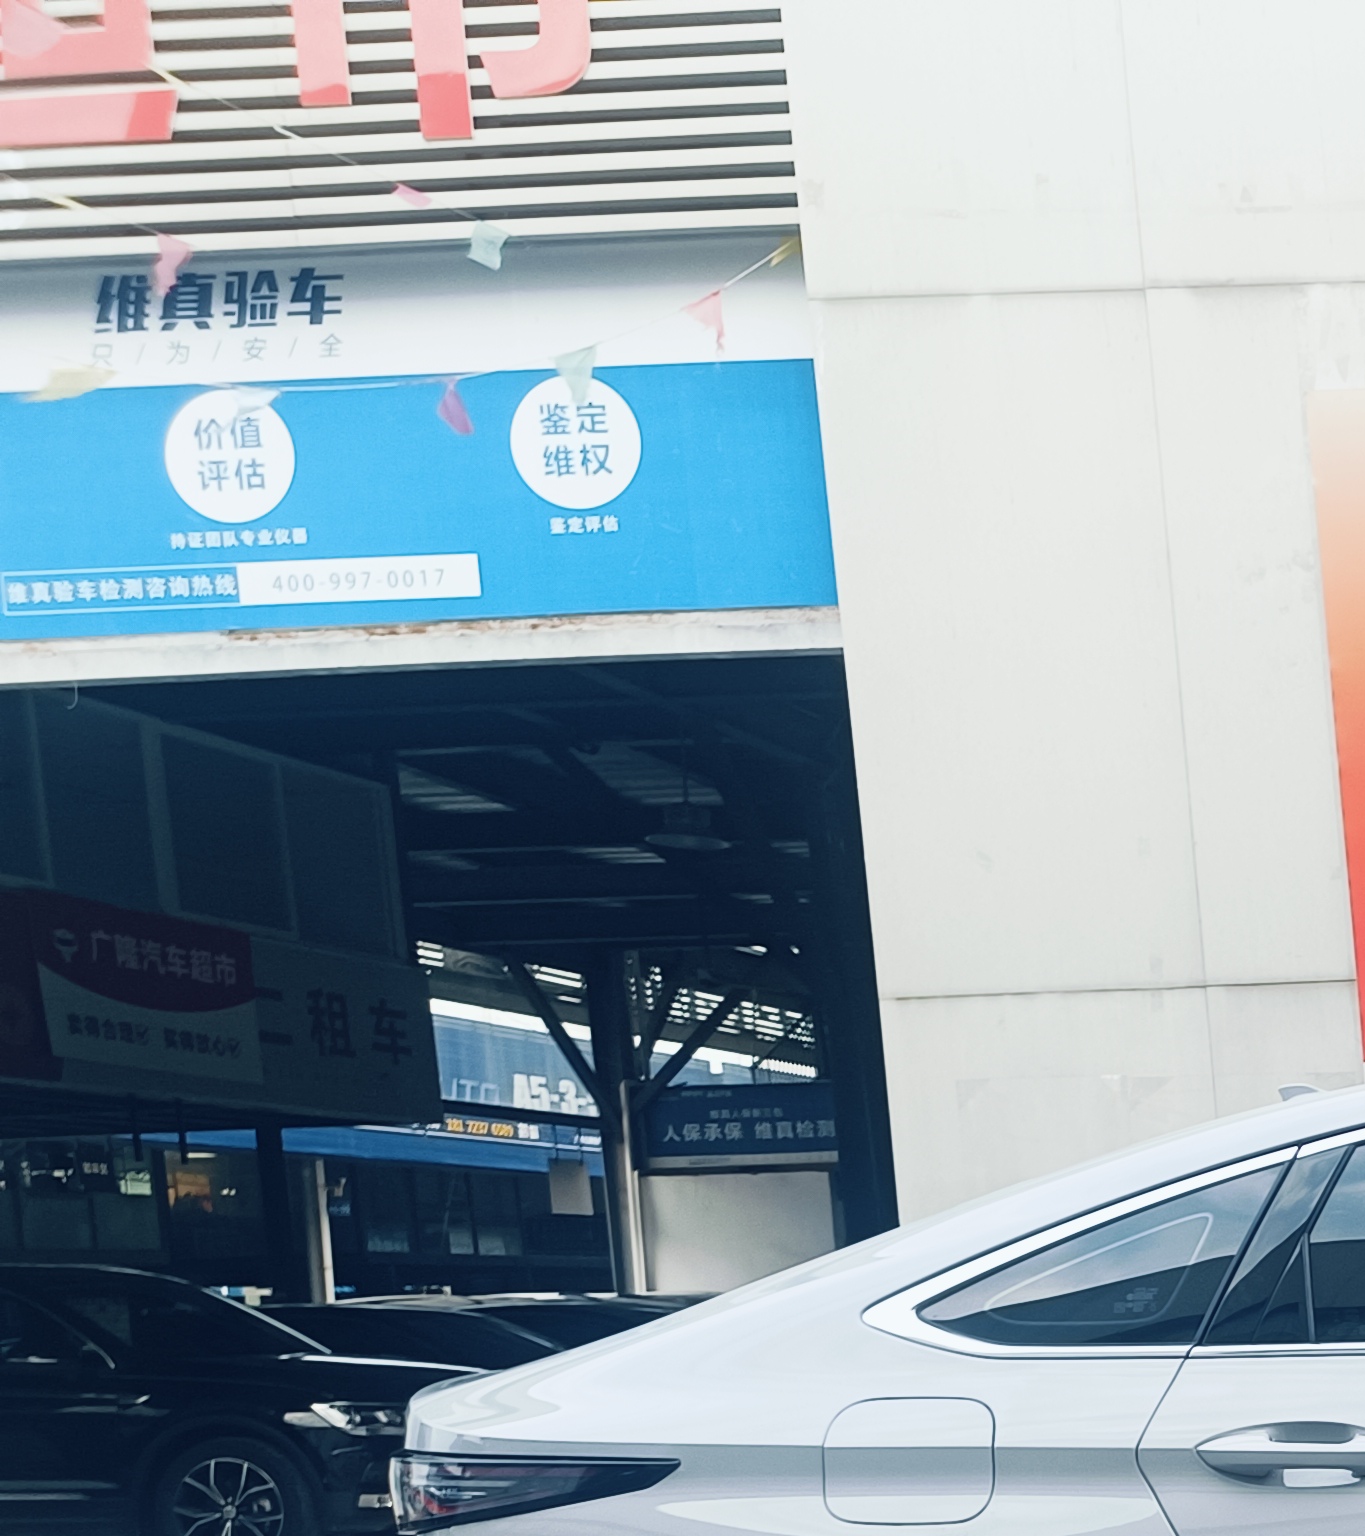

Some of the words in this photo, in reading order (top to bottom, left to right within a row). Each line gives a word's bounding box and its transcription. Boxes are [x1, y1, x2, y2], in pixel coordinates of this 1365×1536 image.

[94, 267, 345, 334] 维真验车
[193, 416, 264, 451] 价值
[539, 402, 610, 436] 鉴定
[197, 458, 267, 492] 评估
[543, 444, 614, 477] 维权
[6, 571, 238, 605] 维真验车检测咨询热线
[271, 568, 446, 594] 400-997-0017
